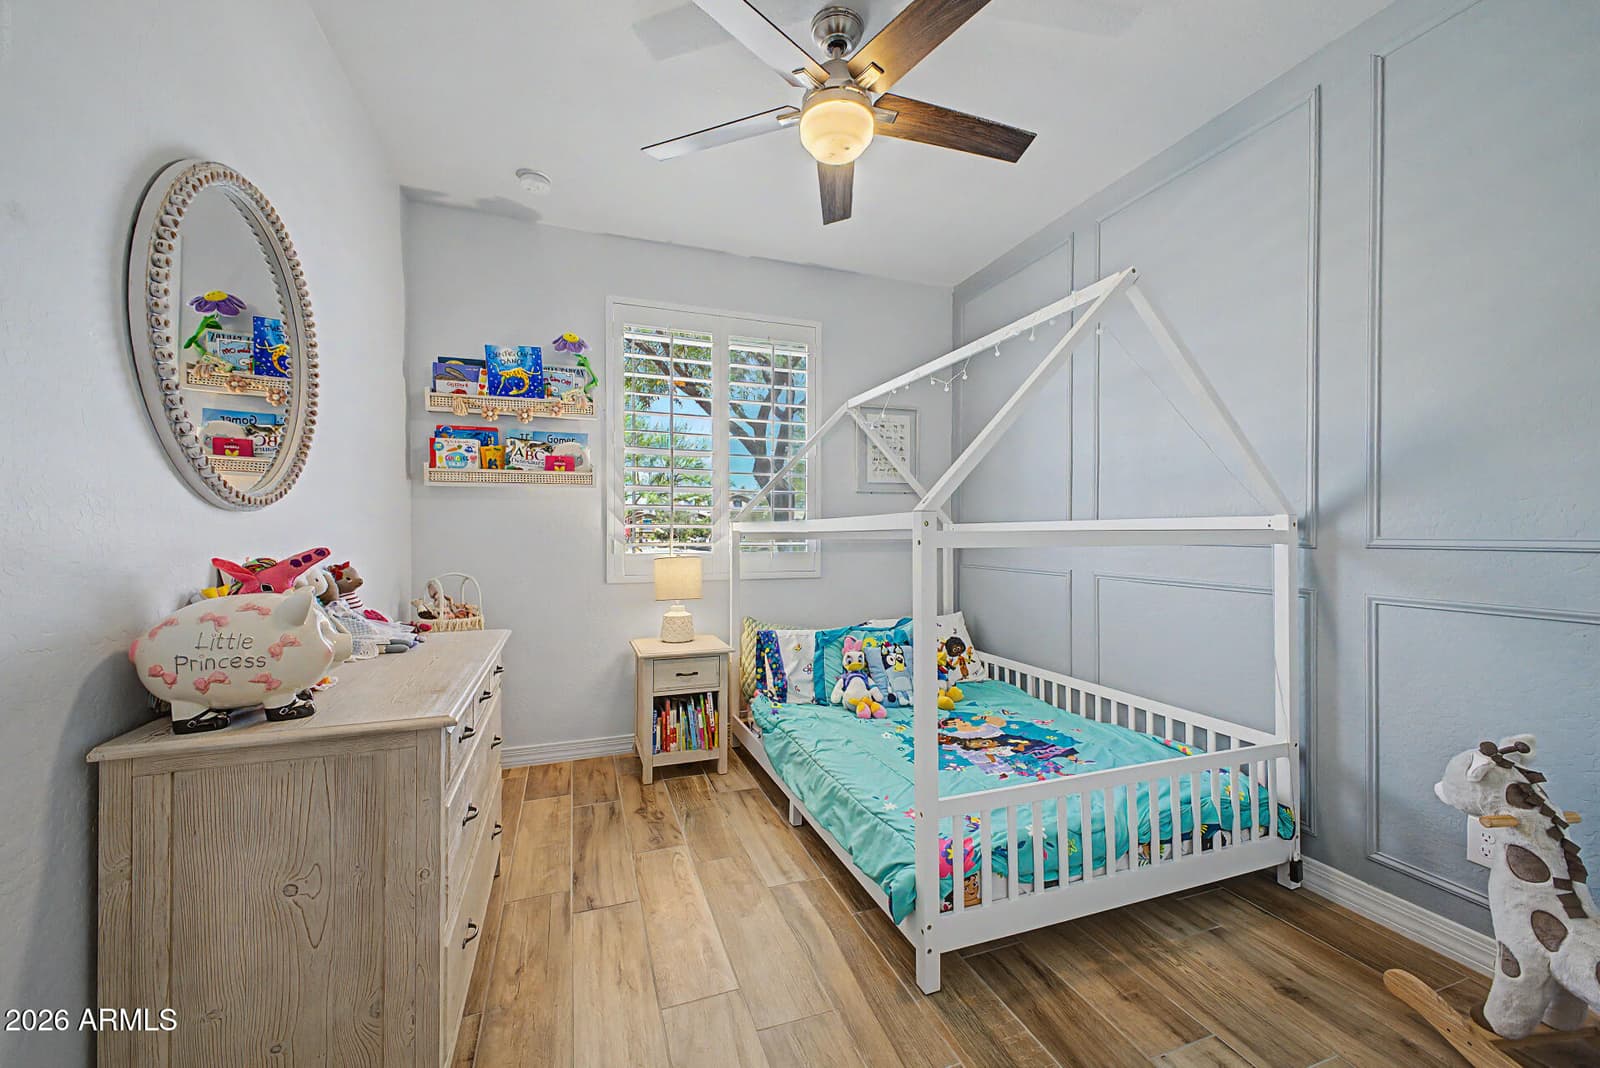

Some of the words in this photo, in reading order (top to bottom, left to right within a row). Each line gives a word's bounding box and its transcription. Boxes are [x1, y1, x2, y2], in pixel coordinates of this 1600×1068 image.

[514, 447, 545, 461] ABC
[194, 631, 254, 651] Little
[174, 654, 267, 674] Princess
